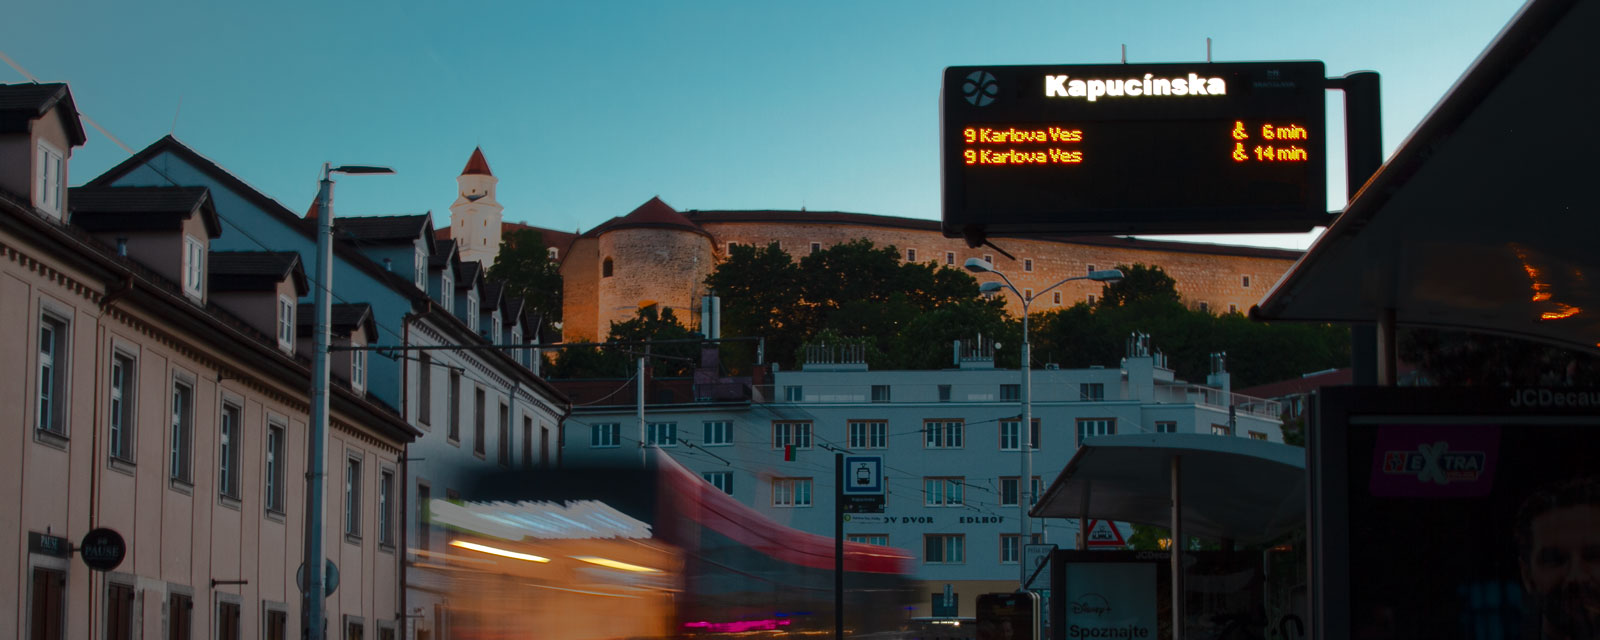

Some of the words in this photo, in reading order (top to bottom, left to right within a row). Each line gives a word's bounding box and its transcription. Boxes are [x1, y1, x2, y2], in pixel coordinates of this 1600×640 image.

[1045, 72, 1226, 102] Kapucínska
[964, 128, 977, 143] 9
[980, 128, 1047, 143] Karlova
[1048, 127, 1083, 142] Ves
[1263, 124, 1275, 140] 6
[1277, 124, 1307, 140] min
[964, 149, 977, 164] 9
[980, 149, 1047, 164] Karlova
[1048, 148, 1083, 163] Ves
[1254, 146, 1275, 161] 14
[1277, 146, 1307, 161] min
[1411, 441, 1479, 485] EXTRA
[903, 516, 934, 524] DVOR
[960, 516, 1005, 524] EDLHOF
[85, 544, 119, 556] PAUSE
[1070, 624, 1149, 640] Spoznajte
